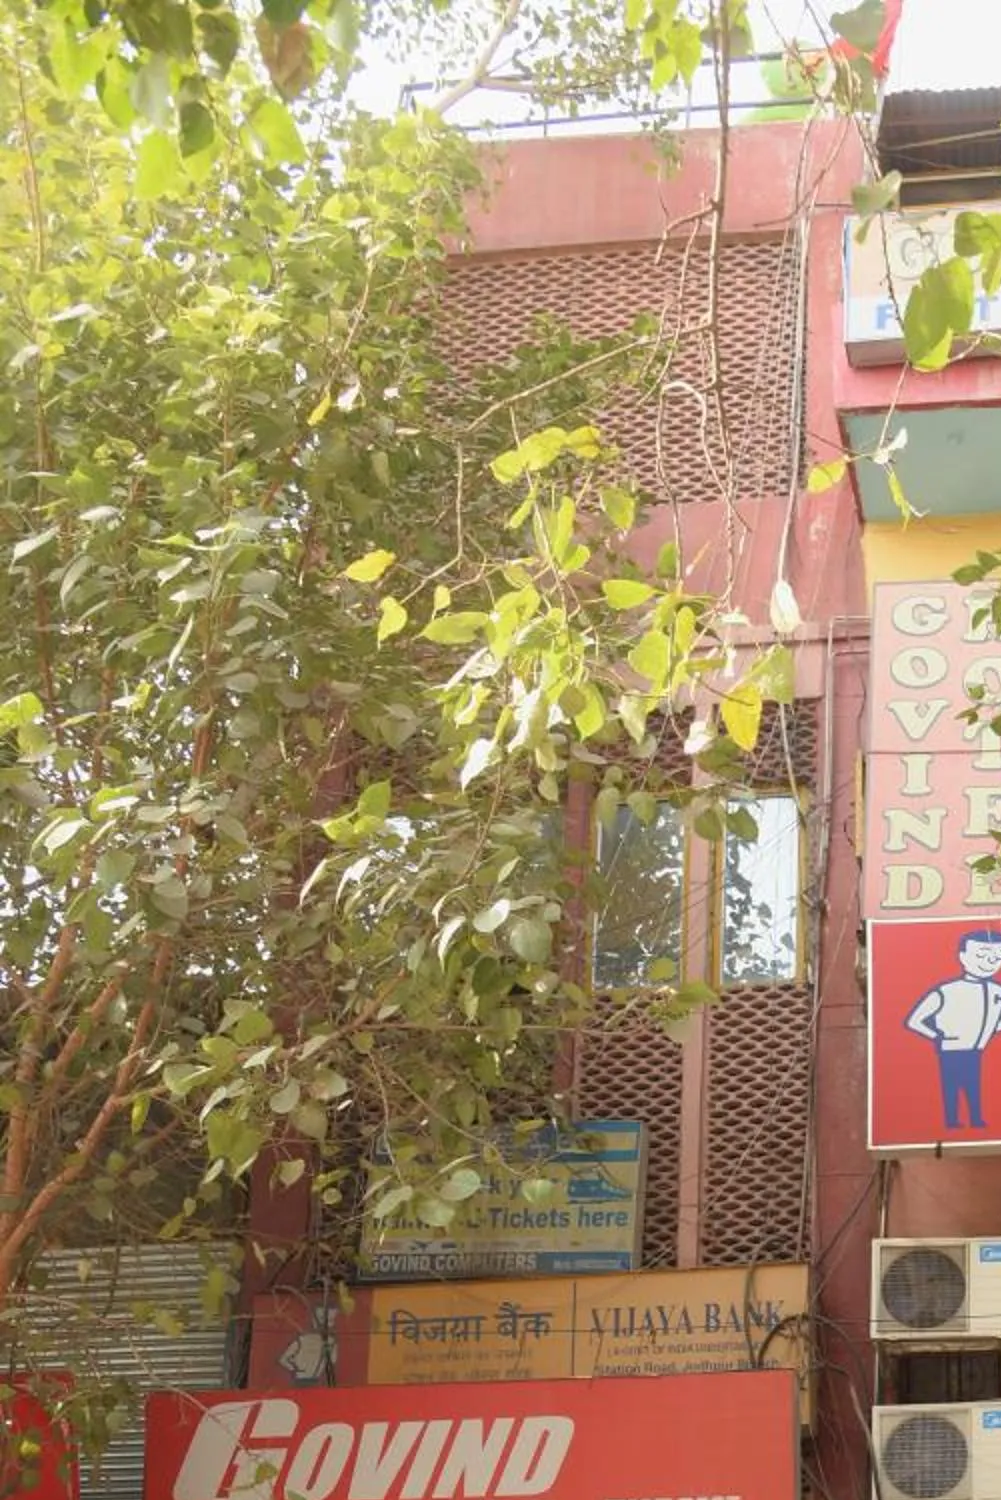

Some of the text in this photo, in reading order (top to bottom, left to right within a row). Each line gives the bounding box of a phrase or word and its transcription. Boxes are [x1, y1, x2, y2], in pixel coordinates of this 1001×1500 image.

[880, 596, 950, 910] GOVIND
[577, 1206, 629, 1228] here
[433, 1252, 538, 1272] COMPUTERS
[386, 1301, 553, 1346] विजया बैंक
[592, 1305, 693, 1338] VIJAYA
